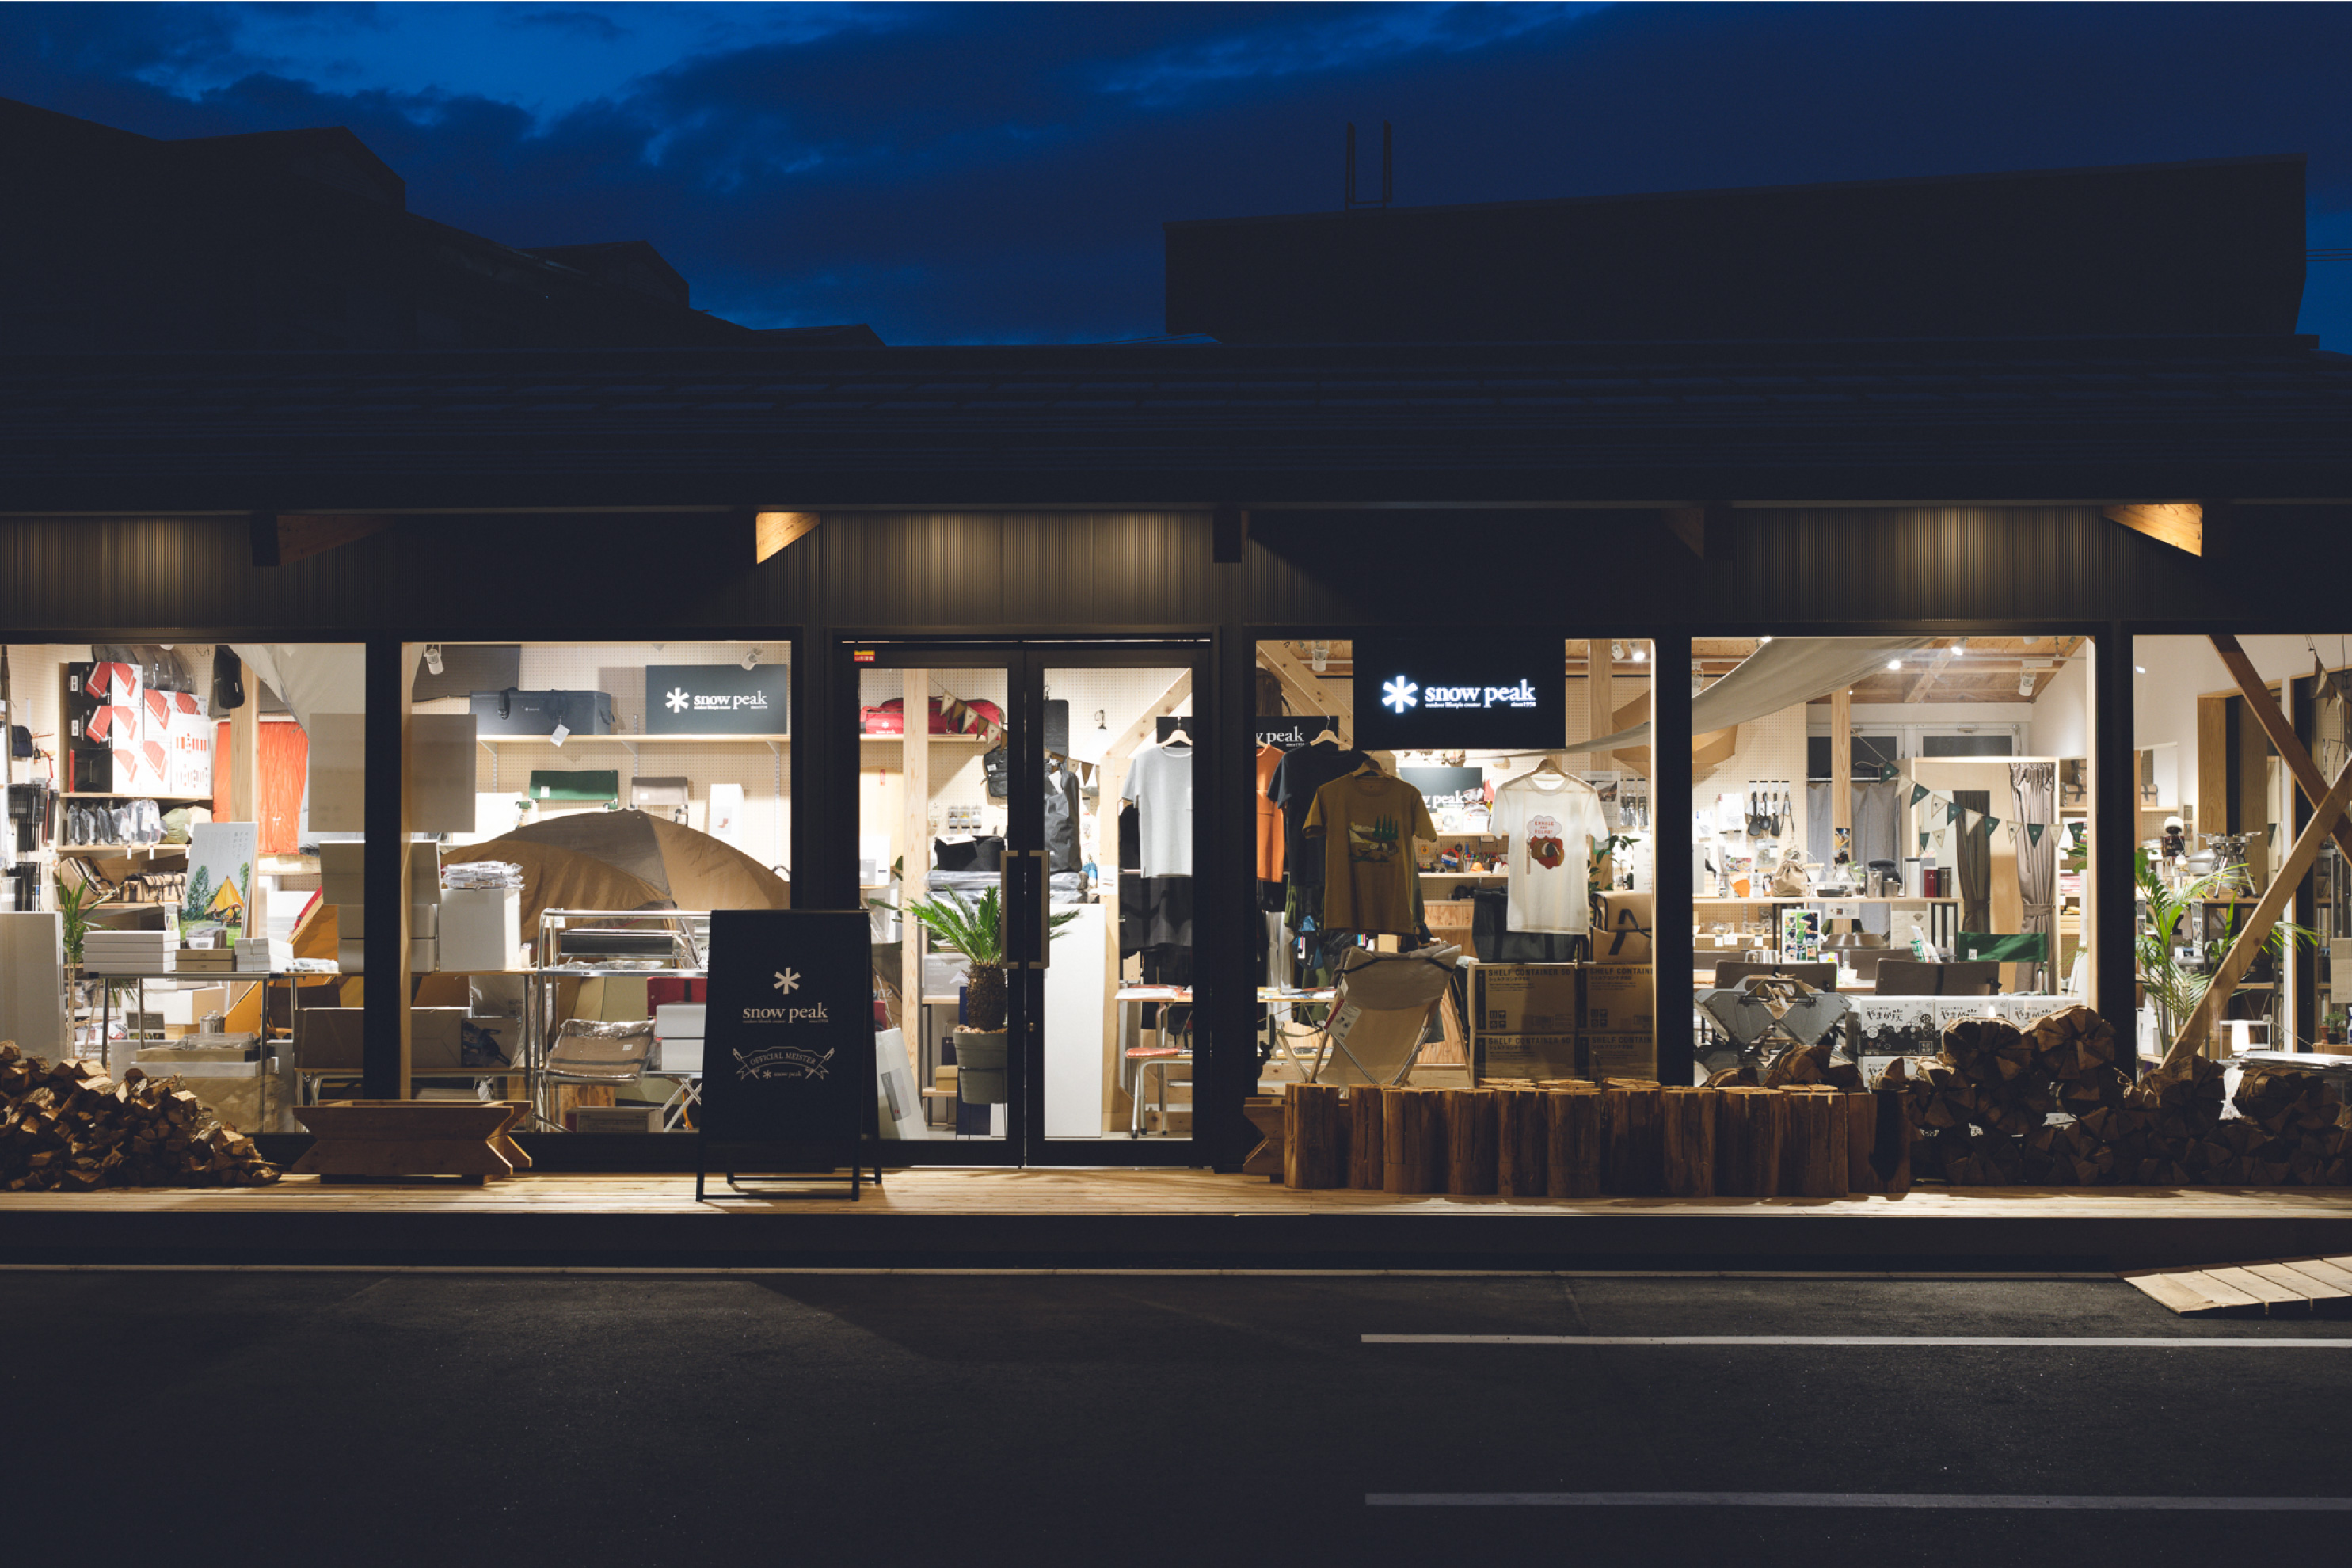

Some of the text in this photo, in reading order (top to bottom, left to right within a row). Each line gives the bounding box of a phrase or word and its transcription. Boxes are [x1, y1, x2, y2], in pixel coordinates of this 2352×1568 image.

[694, 690, 767, 710] snow peak
[1425, 679, 1536, 708] snow peak
[1266, 725, 1304, 745] peak
[1433, 790, 1465, 809] peak
[743, 1002, 828, 1023] snow peak
[1867, 1008, 1904, 1022] やまが炭
[750, 1052, 816, 1065] OFFICIAL MEISTER
